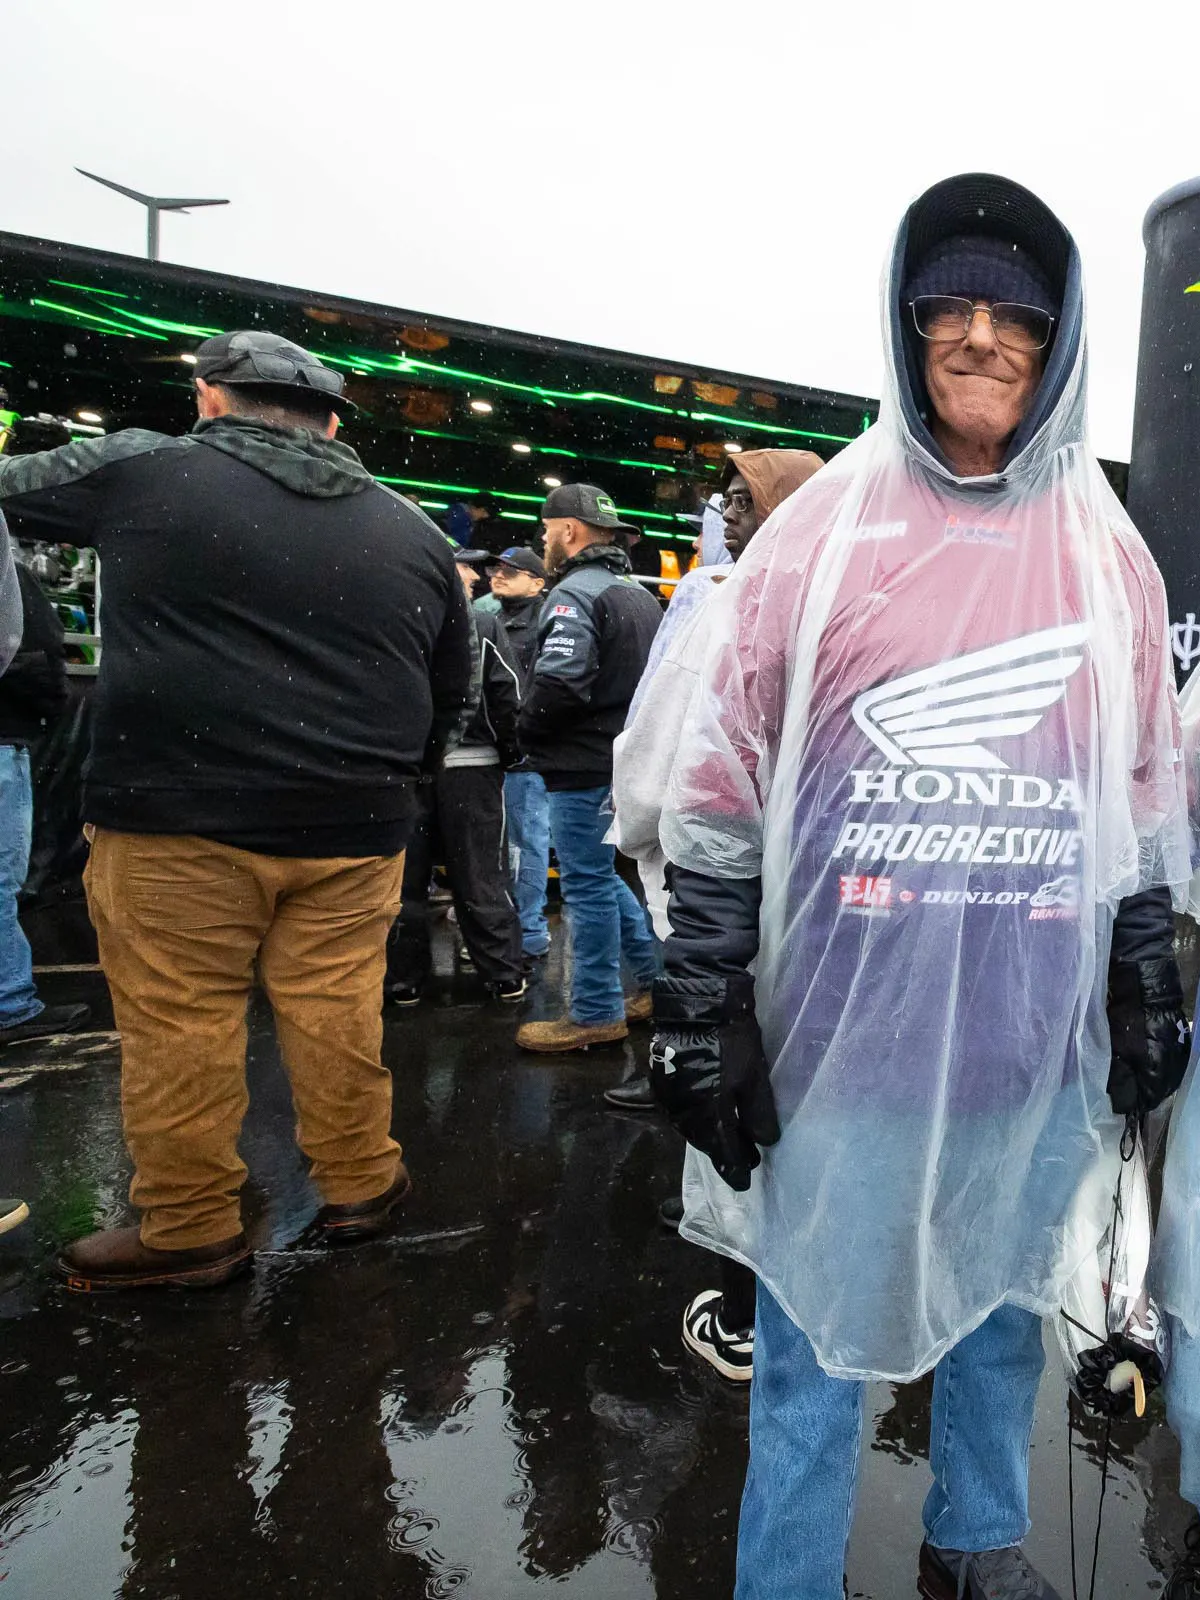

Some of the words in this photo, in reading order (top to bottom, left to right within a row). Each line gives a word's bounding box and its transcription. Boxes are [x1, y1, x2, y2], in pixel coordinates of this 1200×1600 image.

[849, 769, 1086, 812] HONDA
[832, 822, 1084, 866] PROGRESSIVE
[920, 891, 1031, 905] DUNLOP
